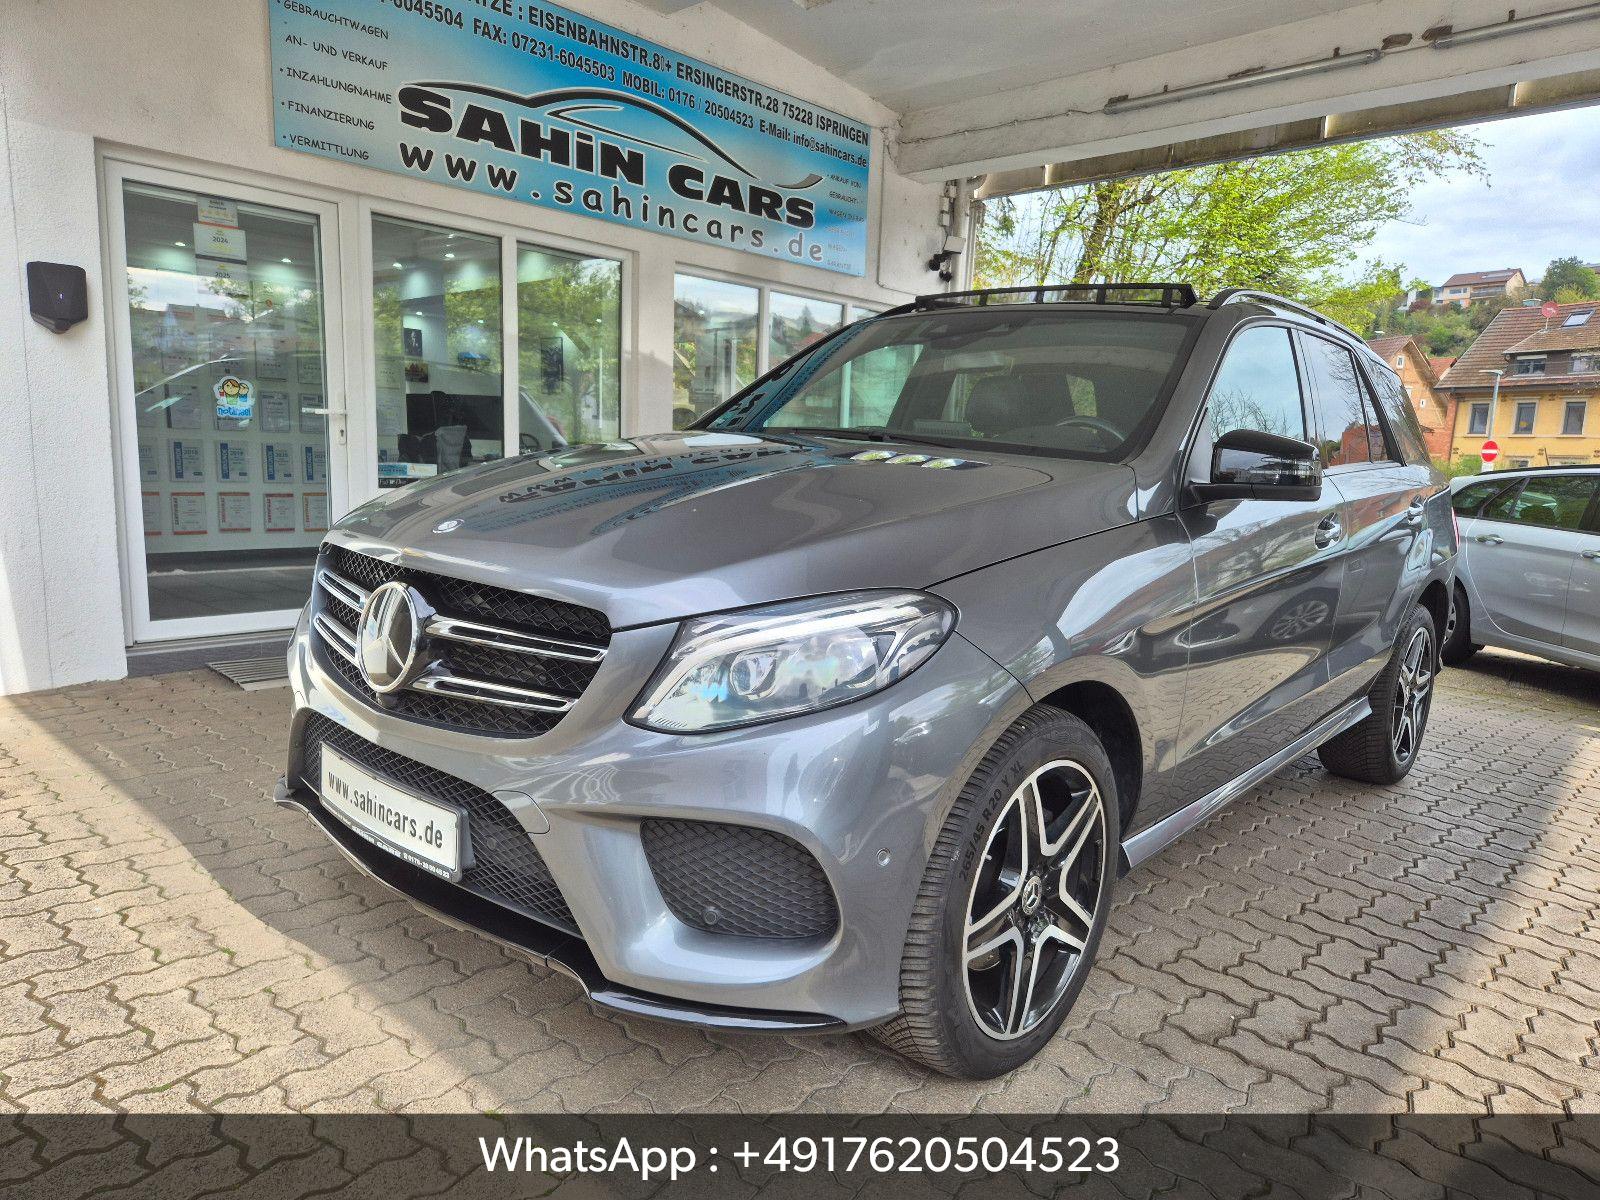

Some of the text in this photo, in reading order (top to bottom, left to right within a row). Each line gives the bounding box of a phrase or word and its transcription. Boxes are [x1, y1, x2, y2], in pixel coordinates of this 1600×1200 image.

[284, 1, 389, 39] GEBRAUCHTWAGEN
[285, 34, 388, 71] AN- UND VERKAUF
[286, 67, 392, 104] INZAHLUNGNAHME
[473, 18, 506, 44] FAX:
[511, 32, 615, 82] 07231-6045503
[622, 70, 665, 99] MOBIL:
[668, 87, 695, 109] 0176
[704, 99, 754, 128] 20504523
[759, 118, 791, 141] E-Mail:
[793, 130, 867, 167] info@sahincars.de
[676, 62, 779, 113] ERSINGERSTR.28
[782, 101, 813, 126] 75228
[816, 114, 869, 146] ISPRINGEN
[288, 100, 375, 131] FINANZIERUNG
[289, 134, 370, 160] VERMITTLUNG
[668, 164, 815, 229] CARS
[328, 772, 443, 848] www.sahincars.de
